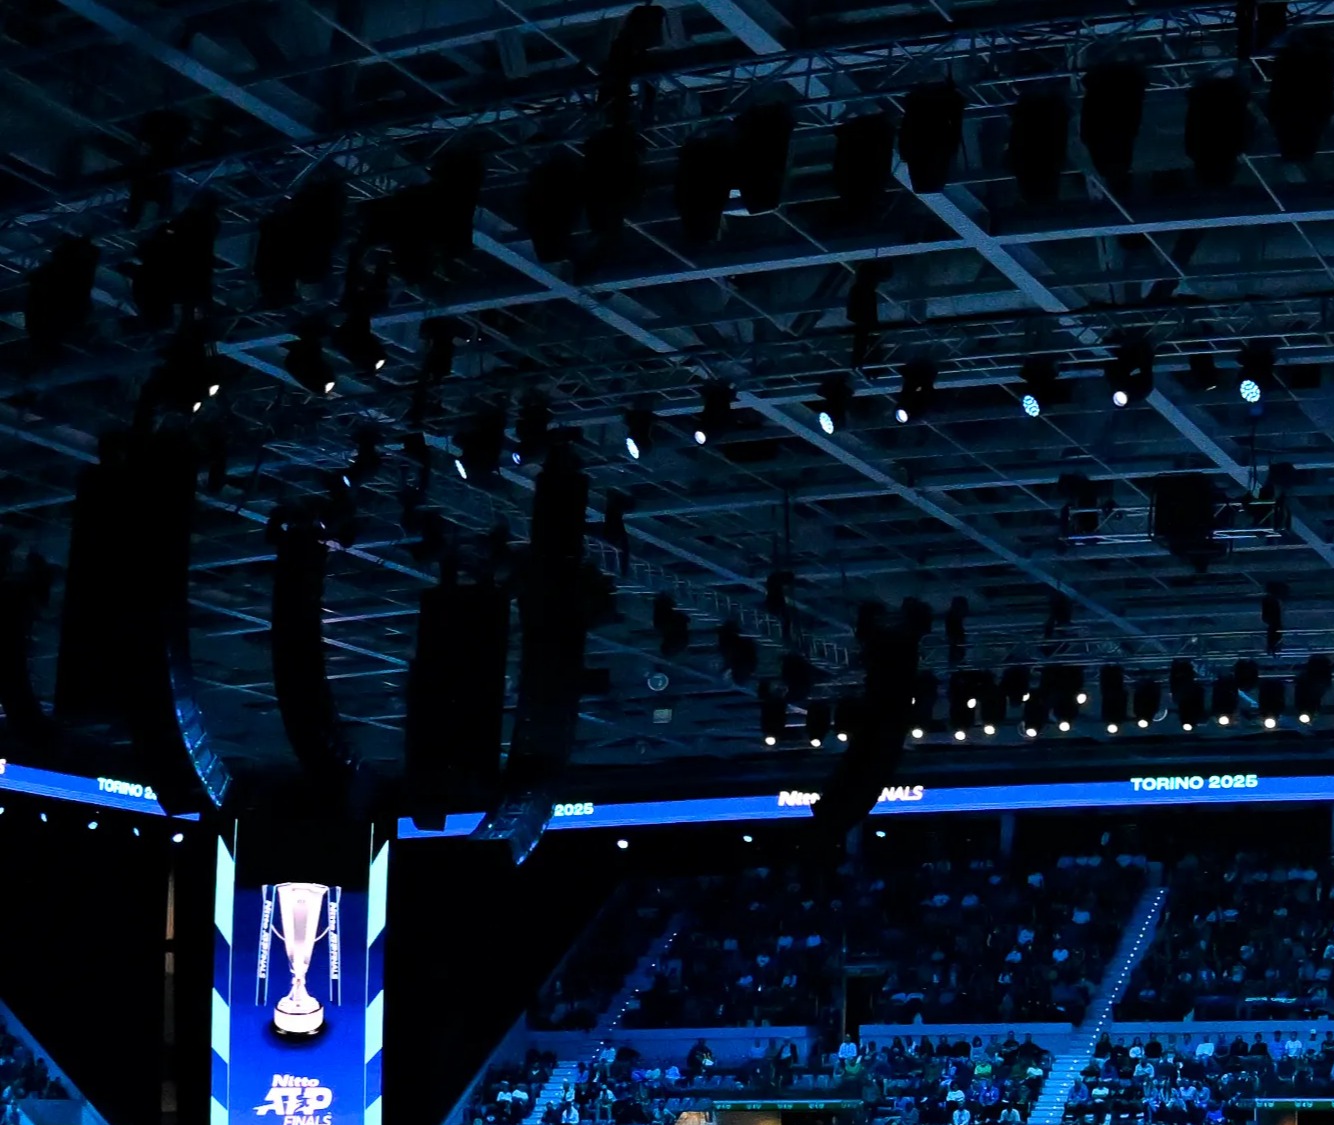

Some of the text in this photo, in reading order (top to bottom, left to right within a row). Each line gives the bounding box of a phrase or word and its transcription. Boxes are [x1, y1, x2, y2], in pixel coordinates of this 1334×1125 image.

[1131, 774, 1259, 792] TORINO 2025
[554, 803, 594, 817] 2025
[271, 1074, 320, 1088] Nitto
[253, 1087, 333, 1116] ATP
